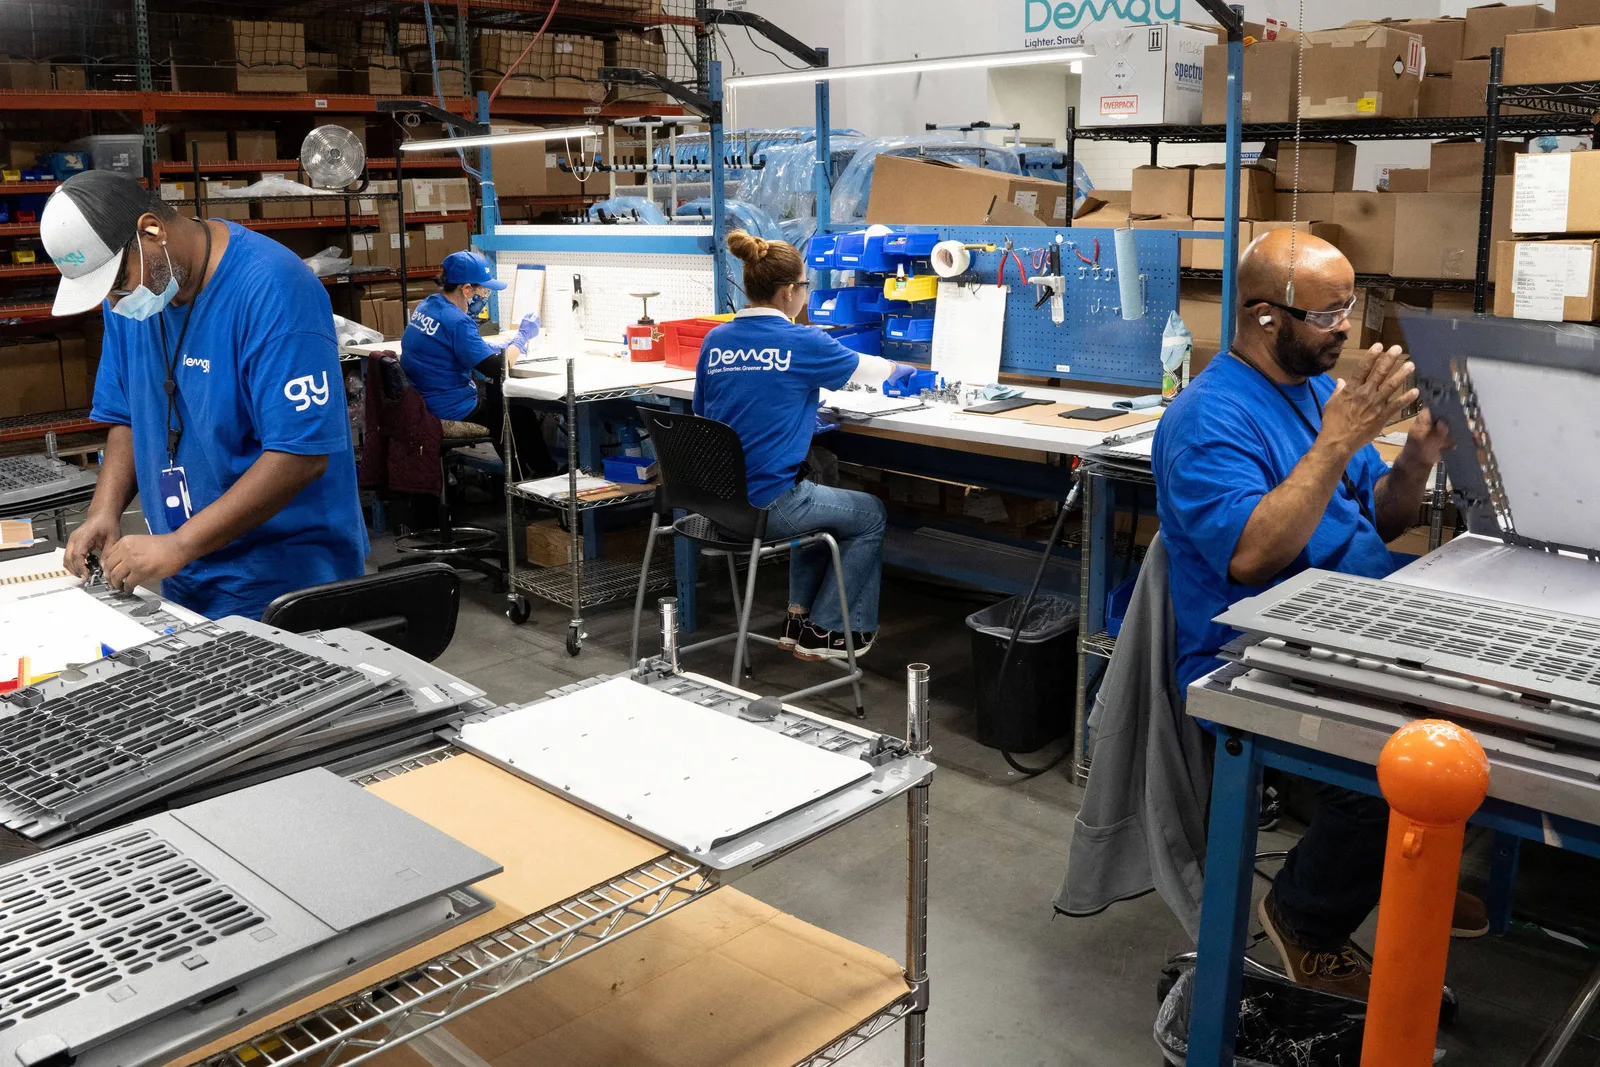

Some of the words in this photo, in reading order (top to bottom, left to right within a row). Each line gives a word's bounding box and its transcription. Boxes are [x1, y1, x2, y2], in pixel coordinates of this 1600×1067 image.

[1025, 36, 1056, 49] Lighter.
[1174, 62, 1203, 81] spectru
[1103, 101, 1135, 110] OVERPACK
[411, 311, 440, 336] emgy
[708, 347, 792, 372] Demgy
[284, 370, 330, 412] gy
